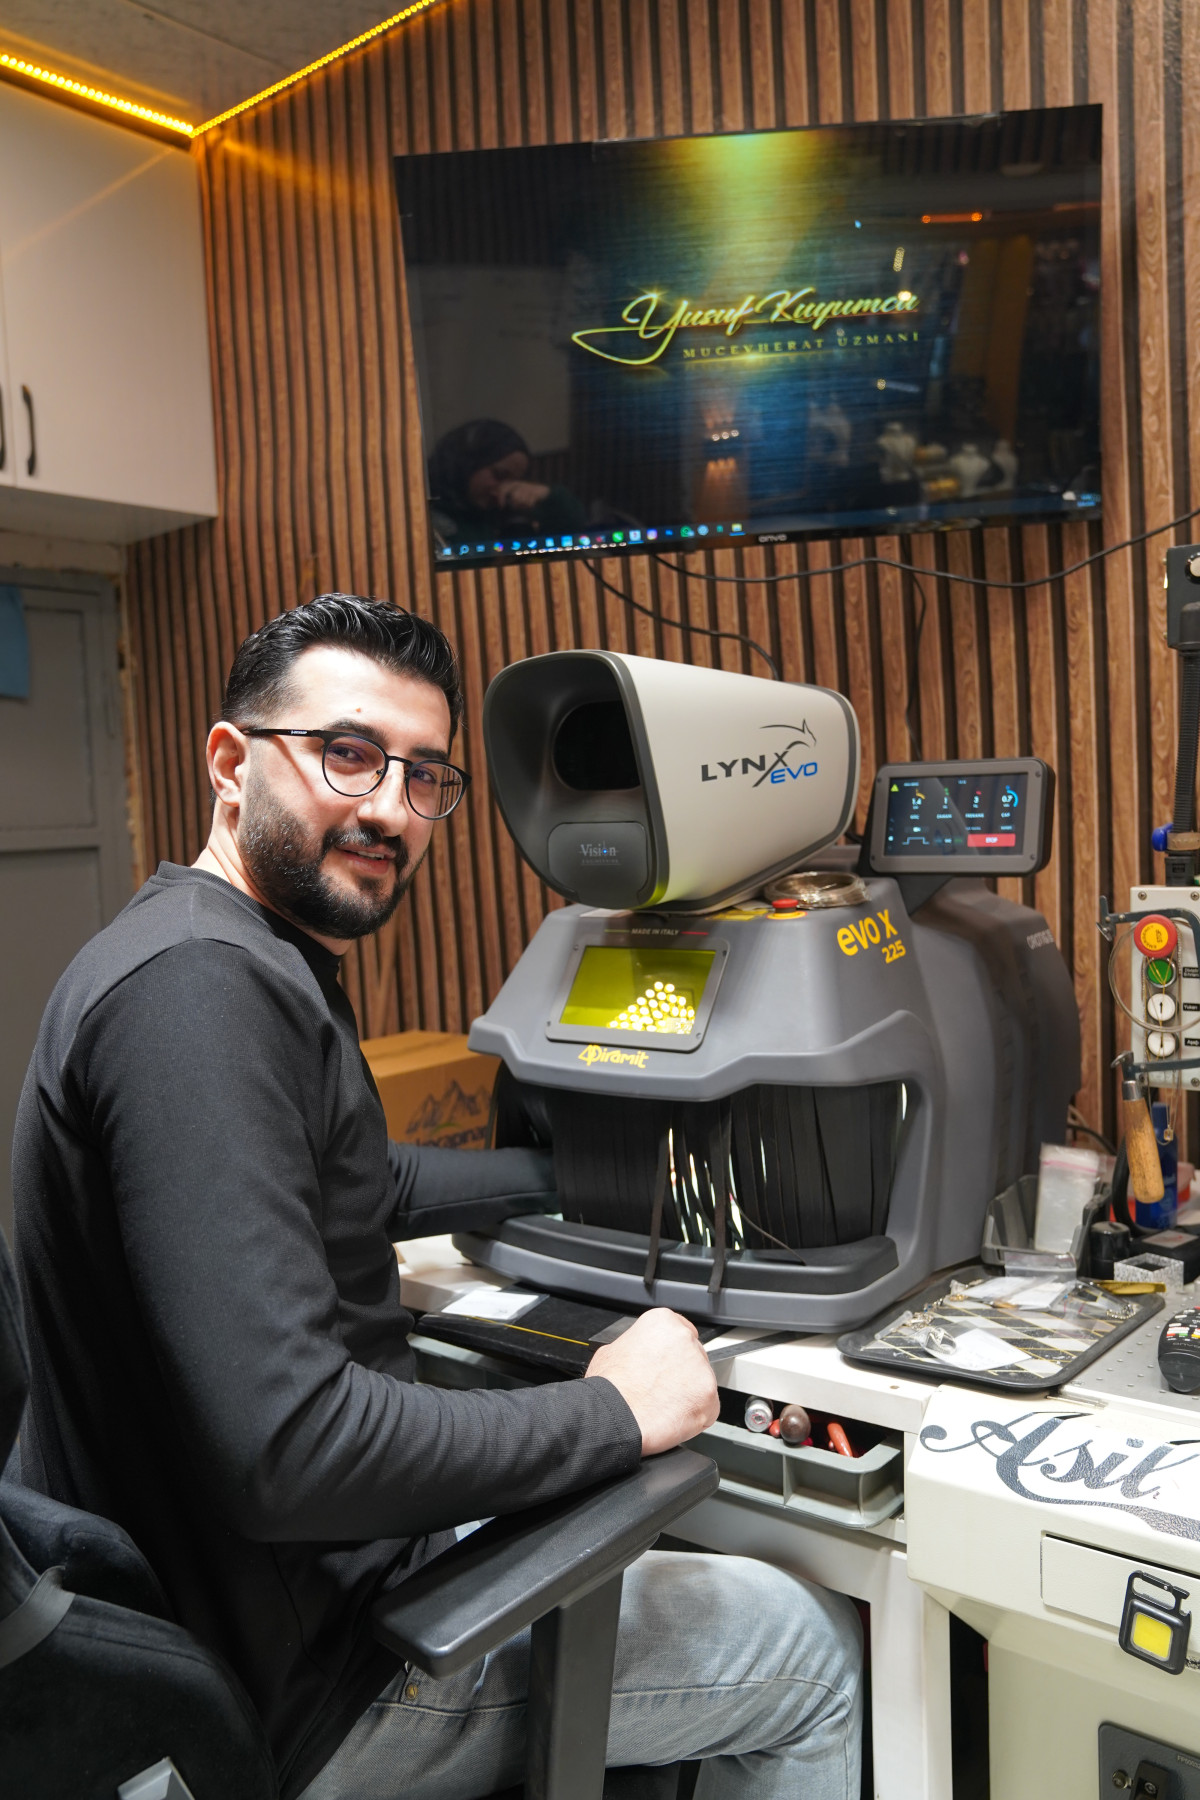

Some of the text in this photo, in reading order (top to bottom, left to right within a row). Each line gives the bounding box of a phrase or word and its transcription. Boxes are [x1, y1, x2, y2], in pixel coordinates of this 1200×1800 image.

[572, 292, 754, 365] Yusuf
[701, 750, 789, 788] LYNX
[771, 762, 818, 784] EVO
[876, 908, 899, 940] X
[881, 939, 907, 964] 225
